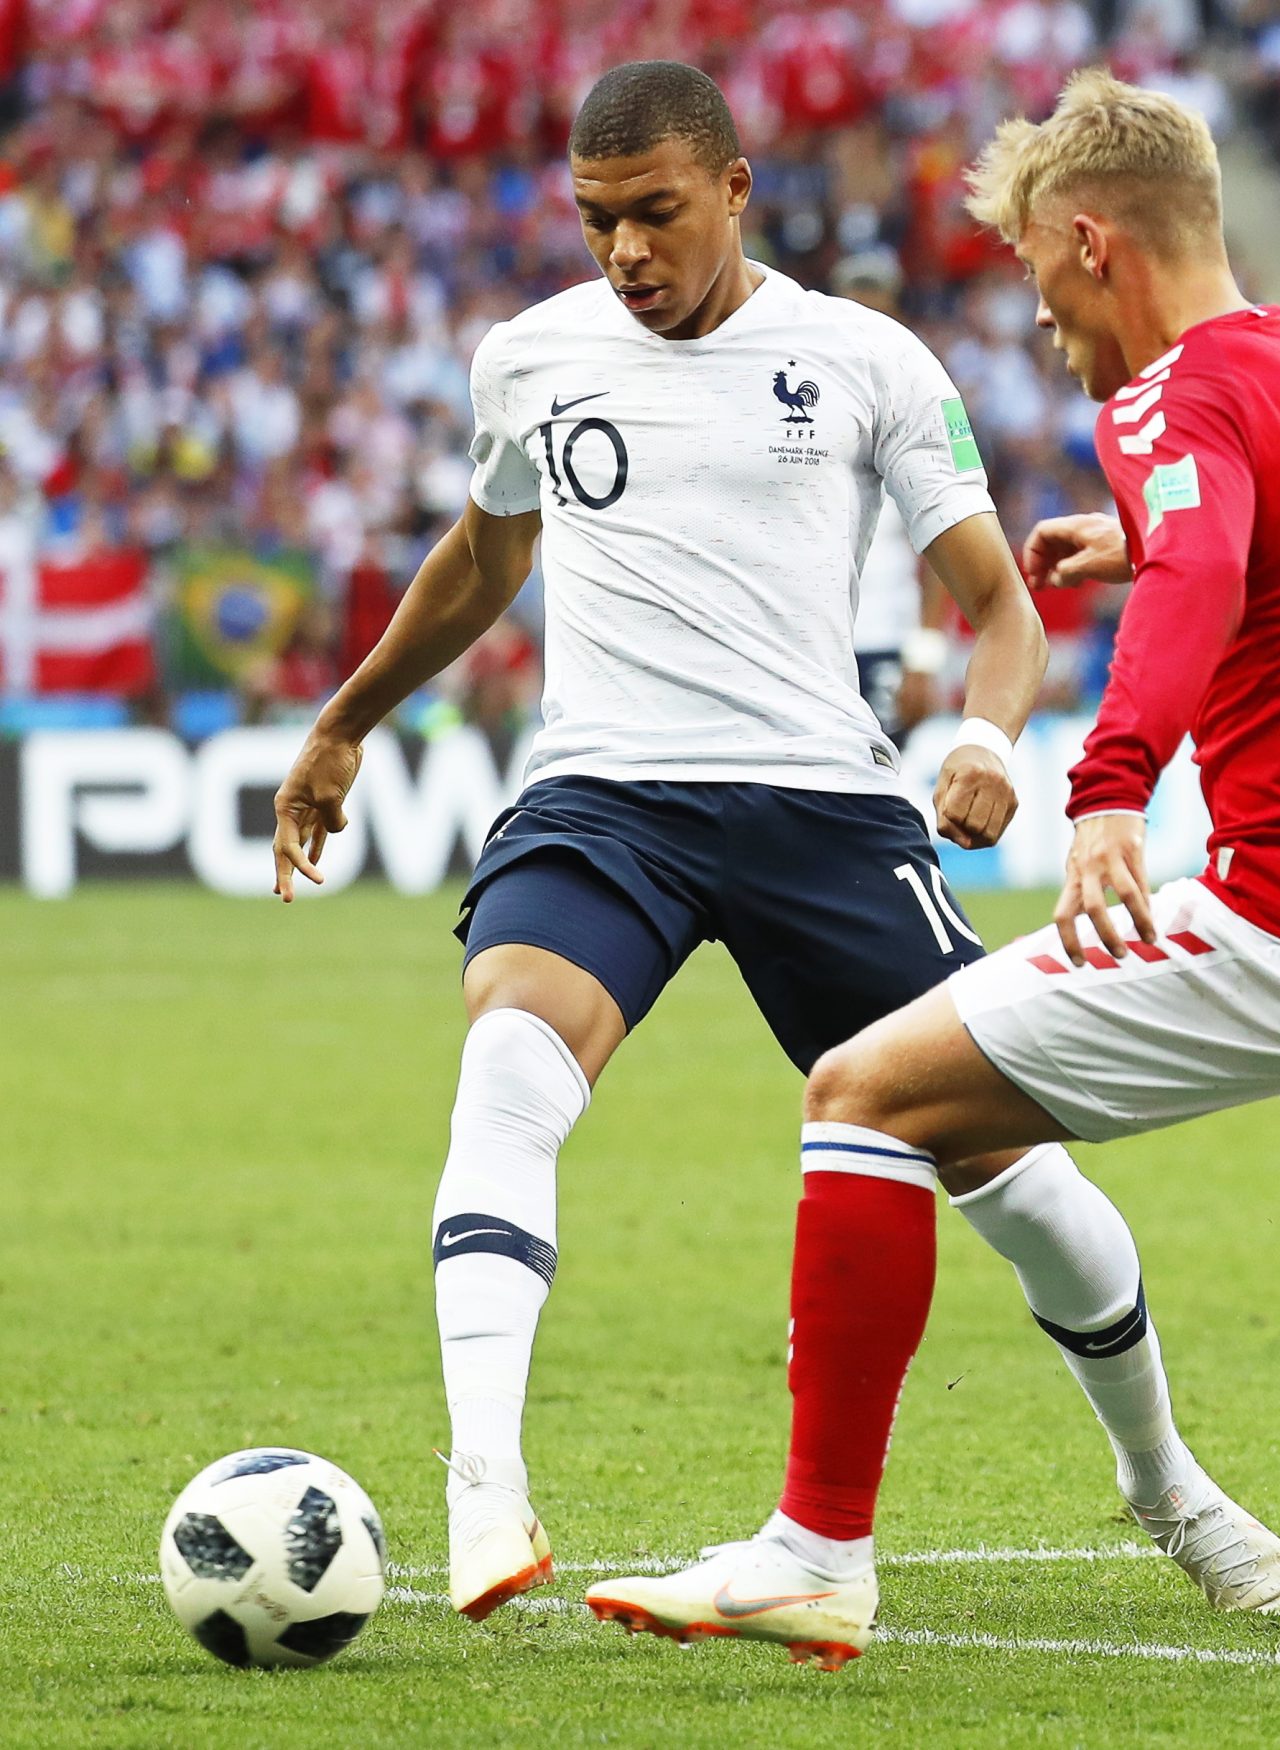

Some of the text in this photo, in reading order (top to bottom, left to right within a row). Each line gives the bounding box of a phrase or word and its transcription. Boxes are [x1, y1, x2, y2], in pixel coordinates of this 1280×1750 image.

[539, 417, 629, 511] 10
[777, 455, 820, 466] 26 JUIN 2018
